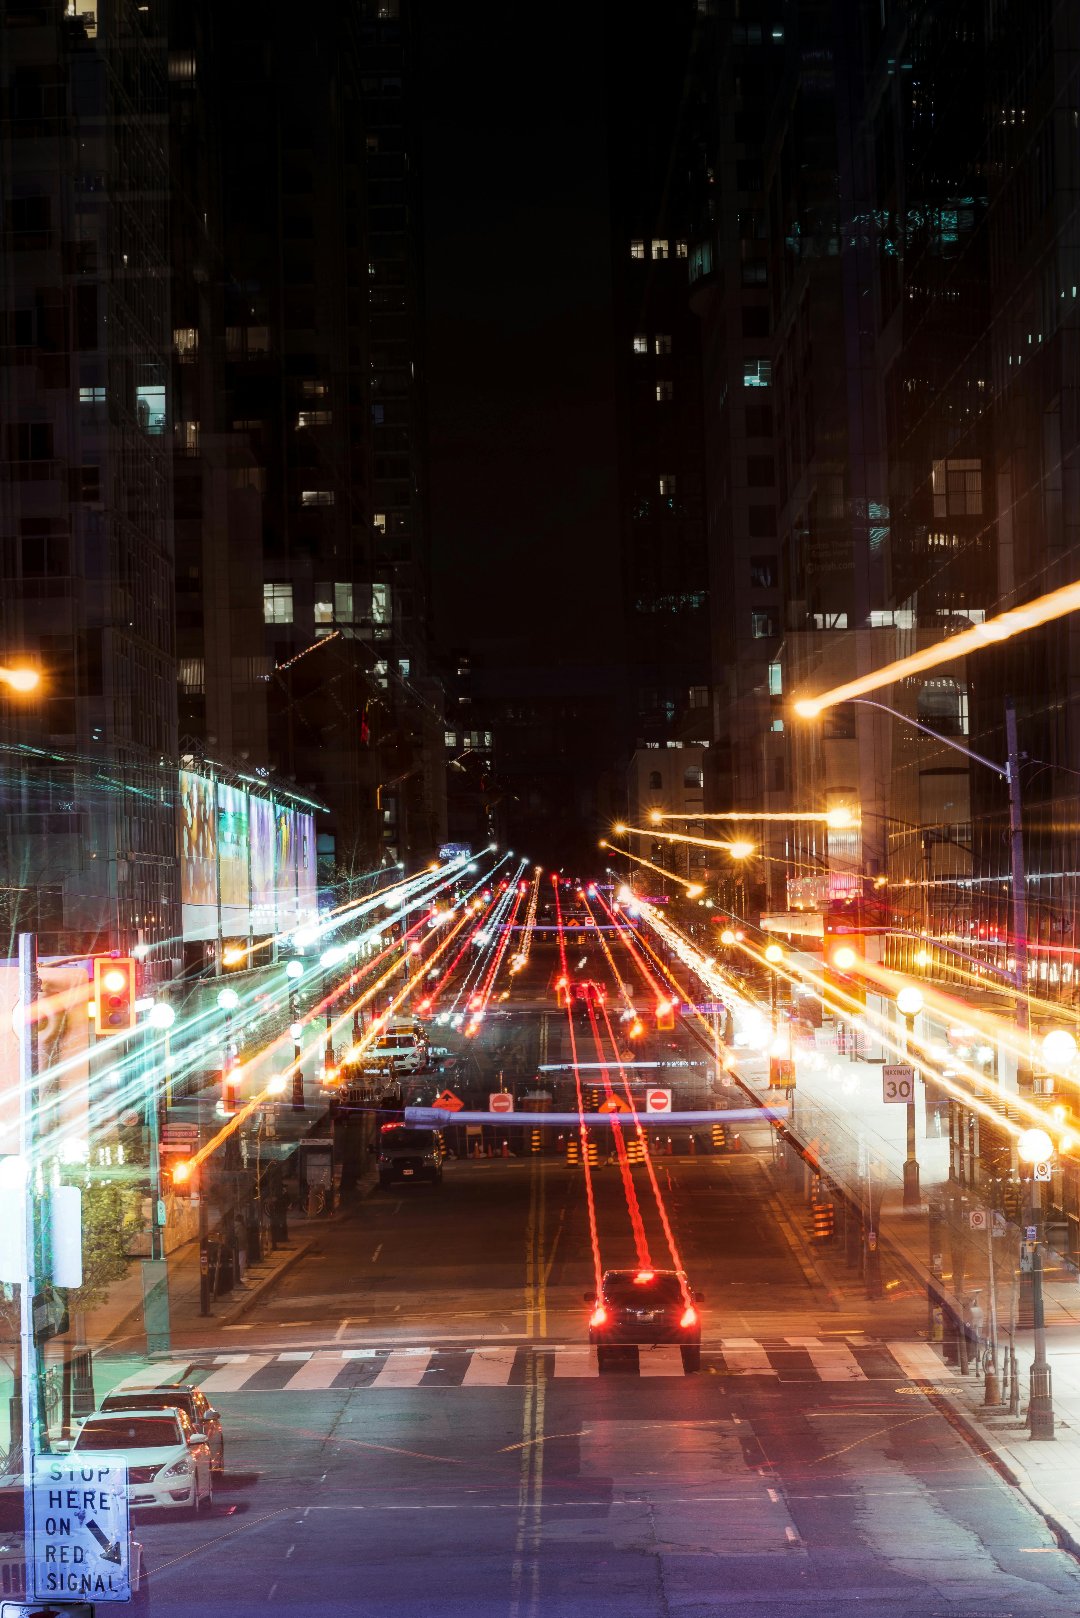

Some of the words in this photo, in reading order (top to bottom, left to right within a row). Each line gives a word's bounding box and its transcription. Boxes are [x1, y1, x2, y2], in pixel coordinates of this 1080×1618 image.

[886, 1081, 910, 1098] 30
[50, 1462, 110, 1482] STOP
[49, 1490, 111, 1510] HERE
[45, 1517, 71, 1536] ON
[45, 1545, 85, 1564] RED
[46, 1573, 119, 1592] SIGNAL
